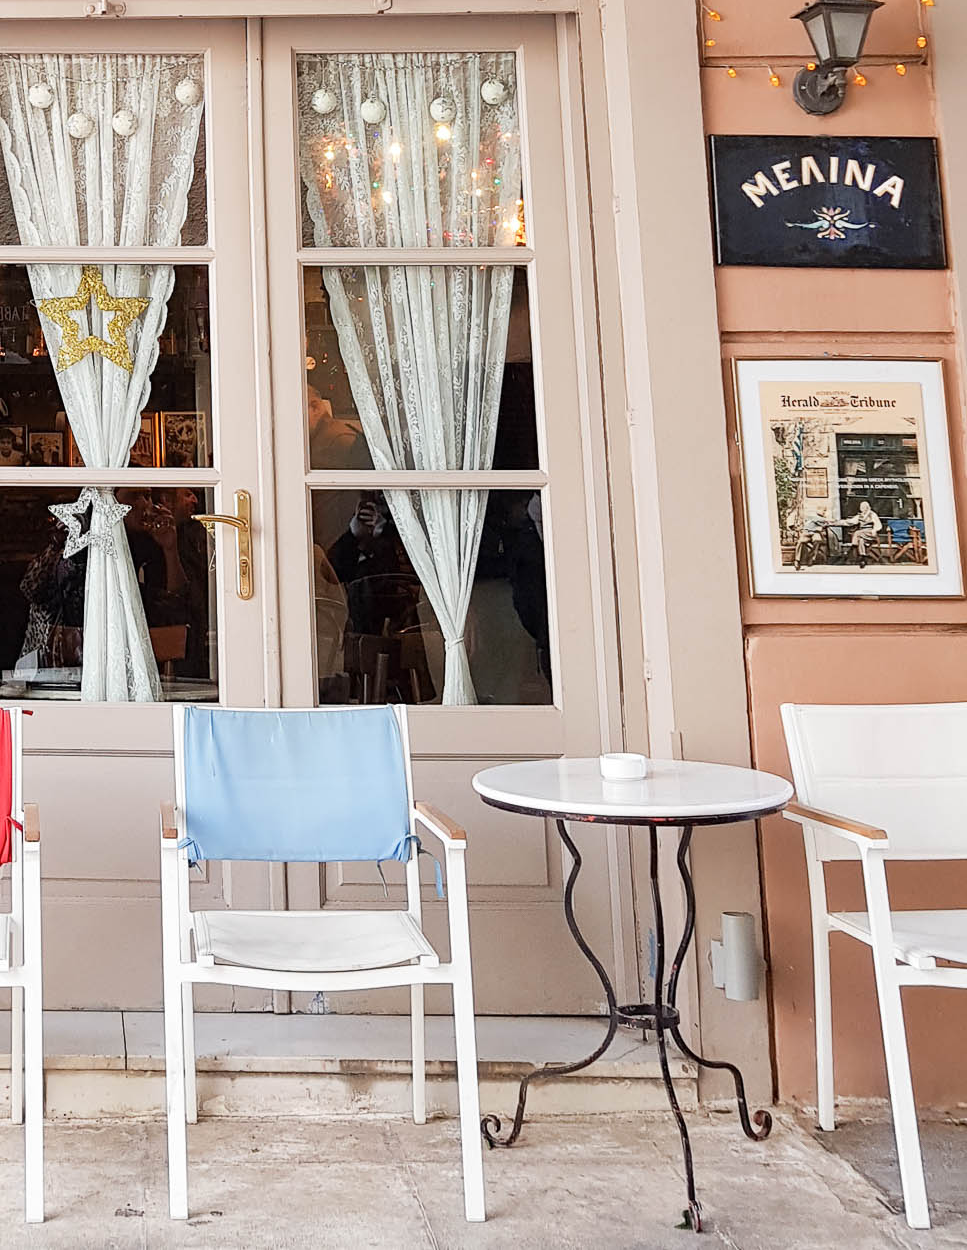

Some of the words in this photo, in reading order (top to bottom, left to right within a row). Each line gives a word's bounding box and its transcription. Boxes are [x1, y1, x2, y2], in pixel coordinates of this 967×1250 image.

[741, 155, 905, 209] ΜΕΛΙΝΑ
[780, 395, 820, 408] Herald
[850, 395, 897, 408] Tribune
